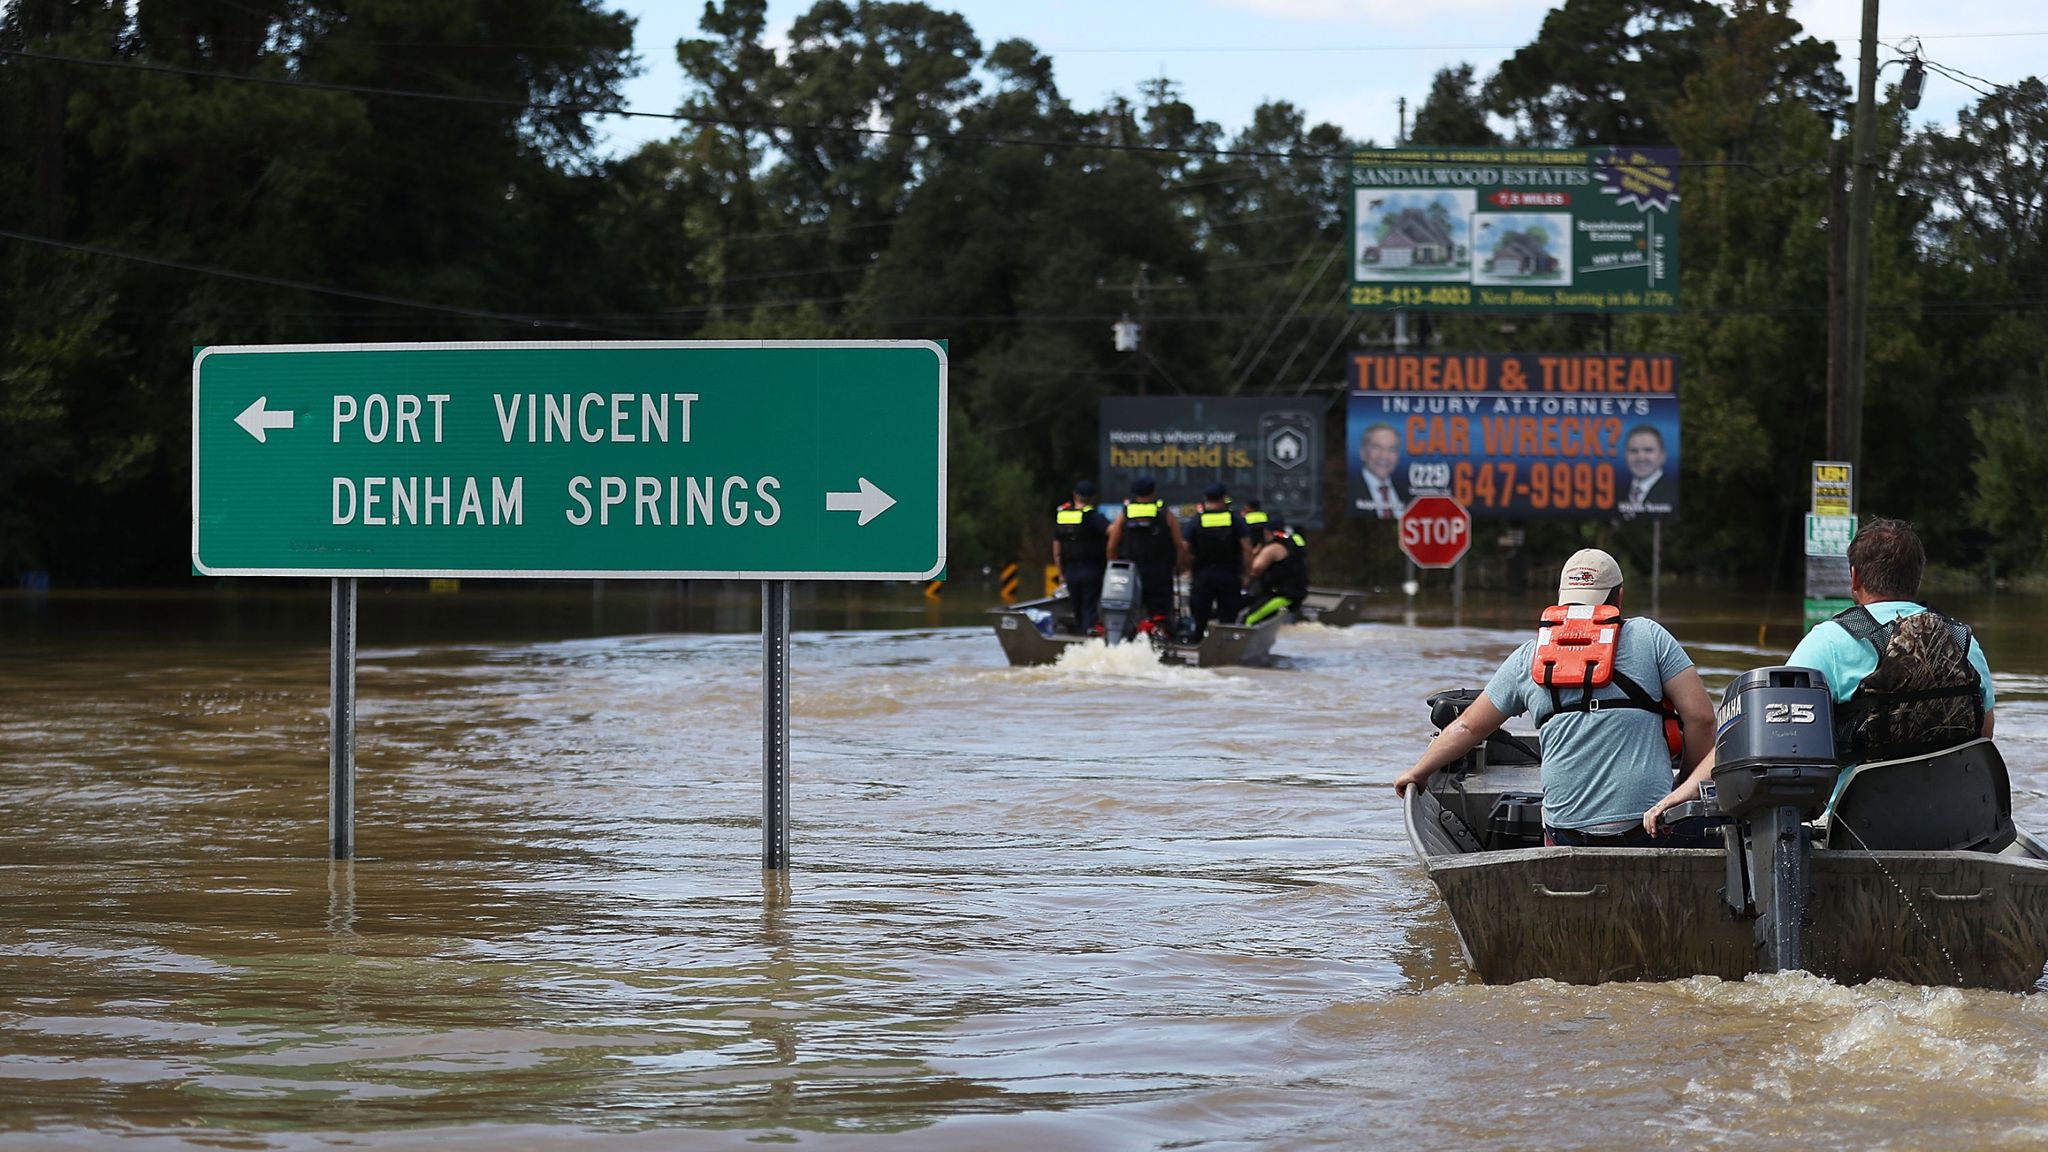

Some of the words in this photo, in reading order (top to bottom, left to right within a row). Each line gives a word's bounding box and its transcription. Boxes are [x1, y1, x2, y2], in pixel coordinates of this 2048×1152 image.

[1504, 152, 1588, 164] SETTLEMENT
[1352, 168, 1499, 186] SANDALWOOD
[1502, 168, 1590, 186] ESTATES
[1522, 191, 1565, 206] MILES
[1577, 220, 1645, 232] Sandalwood
[1553, 289, 1605, 308] Starting
[1606, 290, 1620, 305] in
[1621, 290, 1641, 305] the
[1354, 356, 1488, 391] TUREAU
[1500, 358, 1528, 391] &
[1539, 358, 1673, 393] TUREAU
[1382, 398, 1480, 414] INJURY
[1494, 398, 1650, 416] ATTORNEYS
[332, 393, 450, 444] PORT
[493, 392, 699, 443] VINCENT
[1109, 431, 1149, 444] Home
[1150, 431, 1162, 443] is
[1164, 431, 1203, 444] where
[1206, 431, 1237, 446] your
[1407, 416, 1469, 455] CAR
[1482, 416, 1622, 457] WRECK?
[1109, 444, 1222, 468] handheld
[1226, 444, 1254, 468] is.
[1453, 461, 1616, 510] 647-9999
[332, 476, 523, 526] DENHAM
[565, 475, 782, 527] SPRINGS
[1404, 517, 1466, 546] STOP
[1765, 703, 1816, 724] 25
